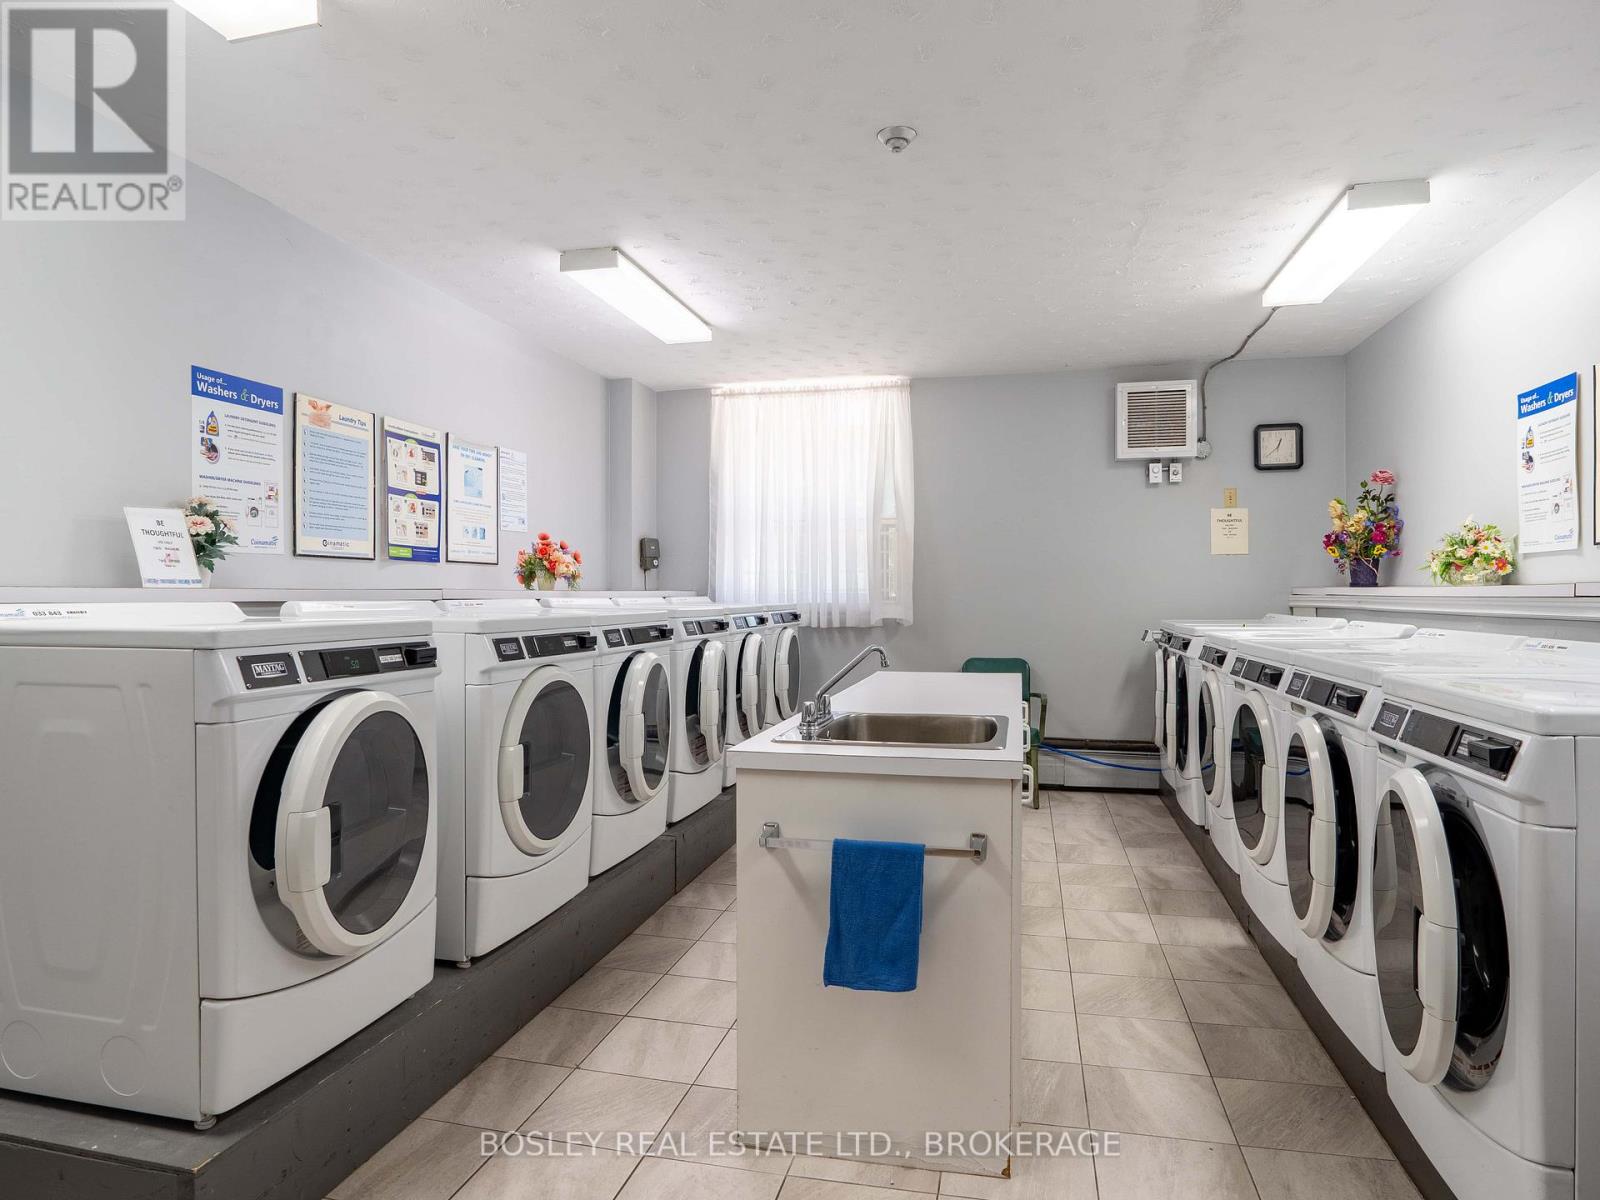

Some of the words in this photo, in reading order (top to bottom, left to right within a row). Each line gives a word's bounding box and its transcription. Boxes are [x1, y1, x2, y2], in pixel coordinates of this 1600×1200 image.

[196, 372, 215, 384] Usage
[196, 381, 238, 400] Washers
[240, 388, 250, 401] &
[250, 394, 280, 409] Dryers
[1520, 400, 1547, 414] Washers
[1547, 391, 1554, 404] &
[1554, 388, 1574, 402] Dryers
[339, 414, 357, 424] Laundry
[358, 418, 367, 427] Tips
[156, 519, 165, 527] BE
[141, 528, 184, 539] THOUGHTFUL
[254, 662, 286, 674] MAYTAG
